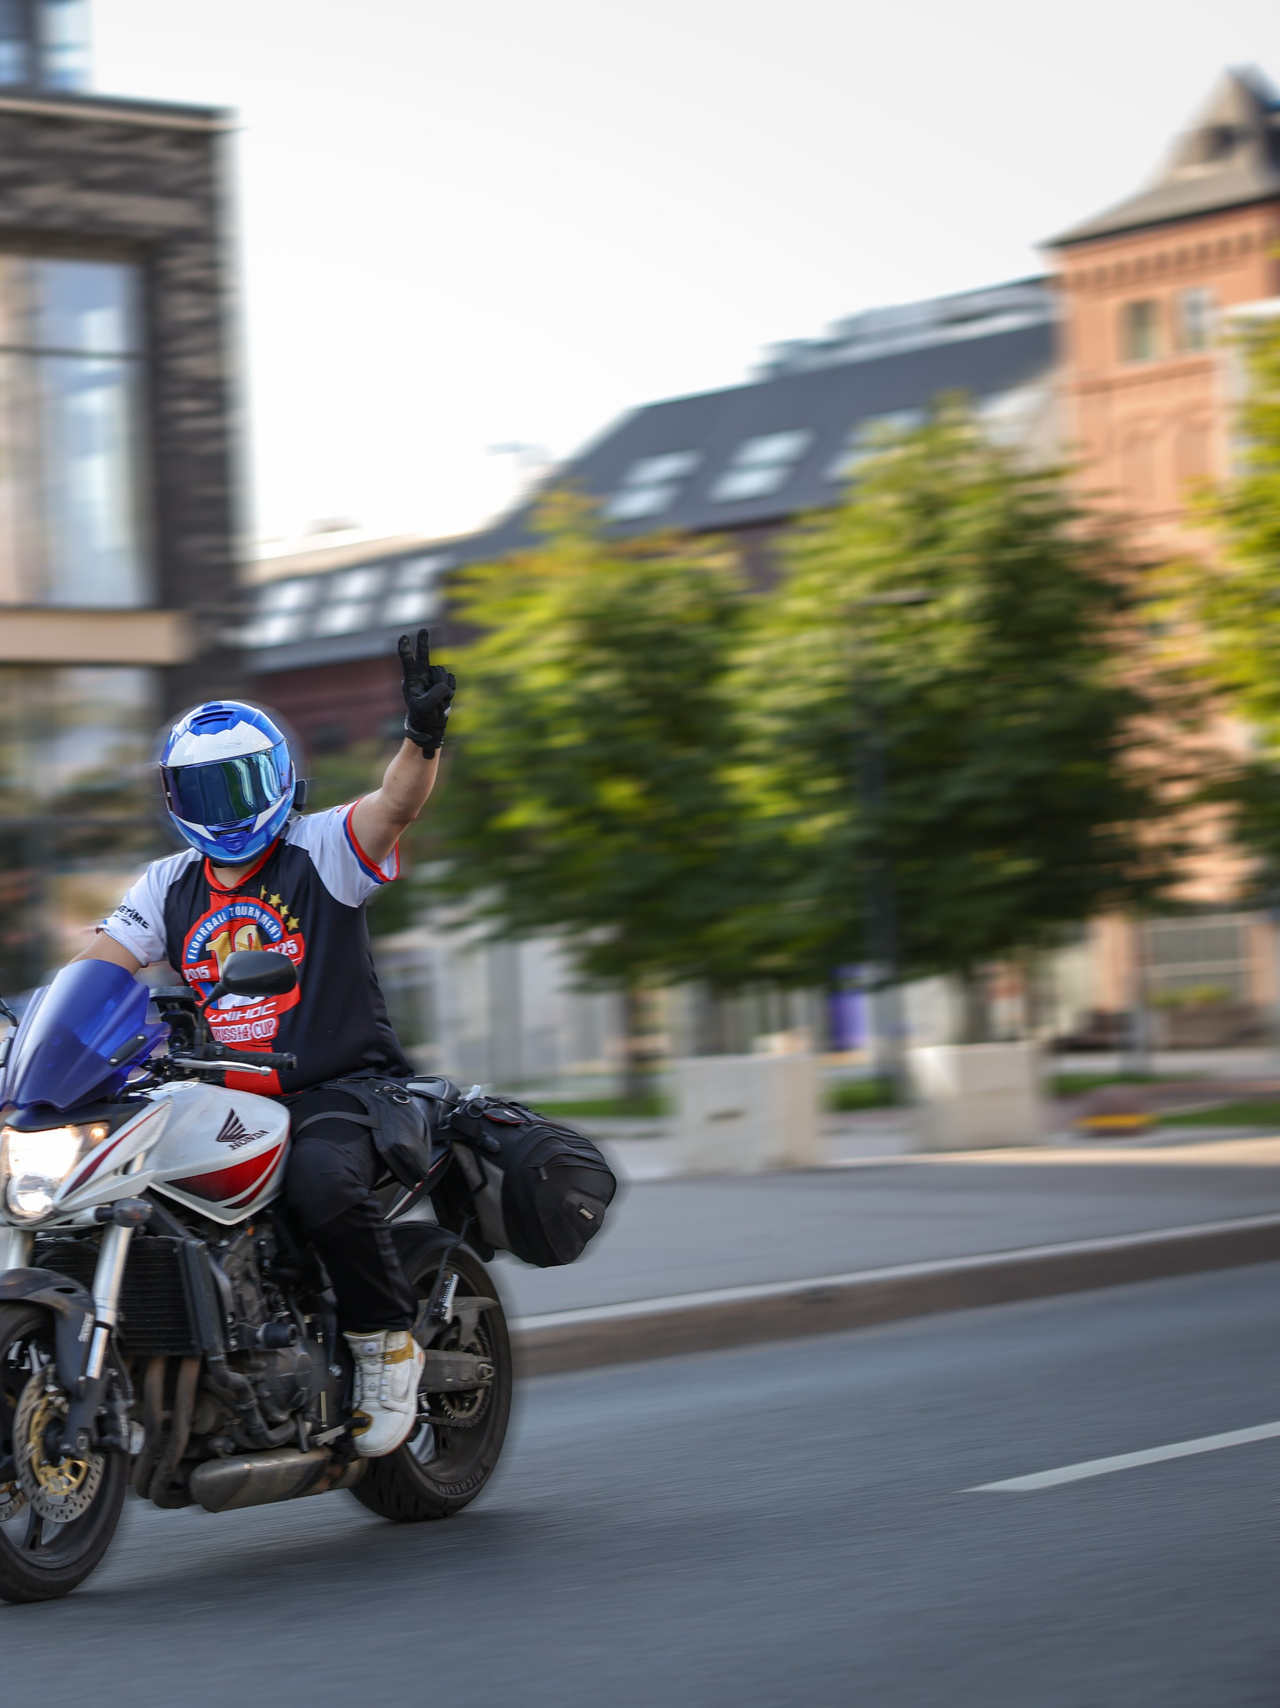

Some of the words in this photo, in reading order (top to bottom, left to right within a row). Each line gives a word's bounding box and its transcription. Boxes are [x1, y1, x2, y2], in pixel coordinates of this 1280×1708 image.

[187, 912, 228, 960] FLOORBALL
[183, 965, 211, 982] 2015
[208, 1002, 277, 1022] UNIHOC
[252, 1018, 276, 1039] CUP
[227, 1130, 270, 1151] HONDA
[438, 1465, 485, 1495] MICHELIN
